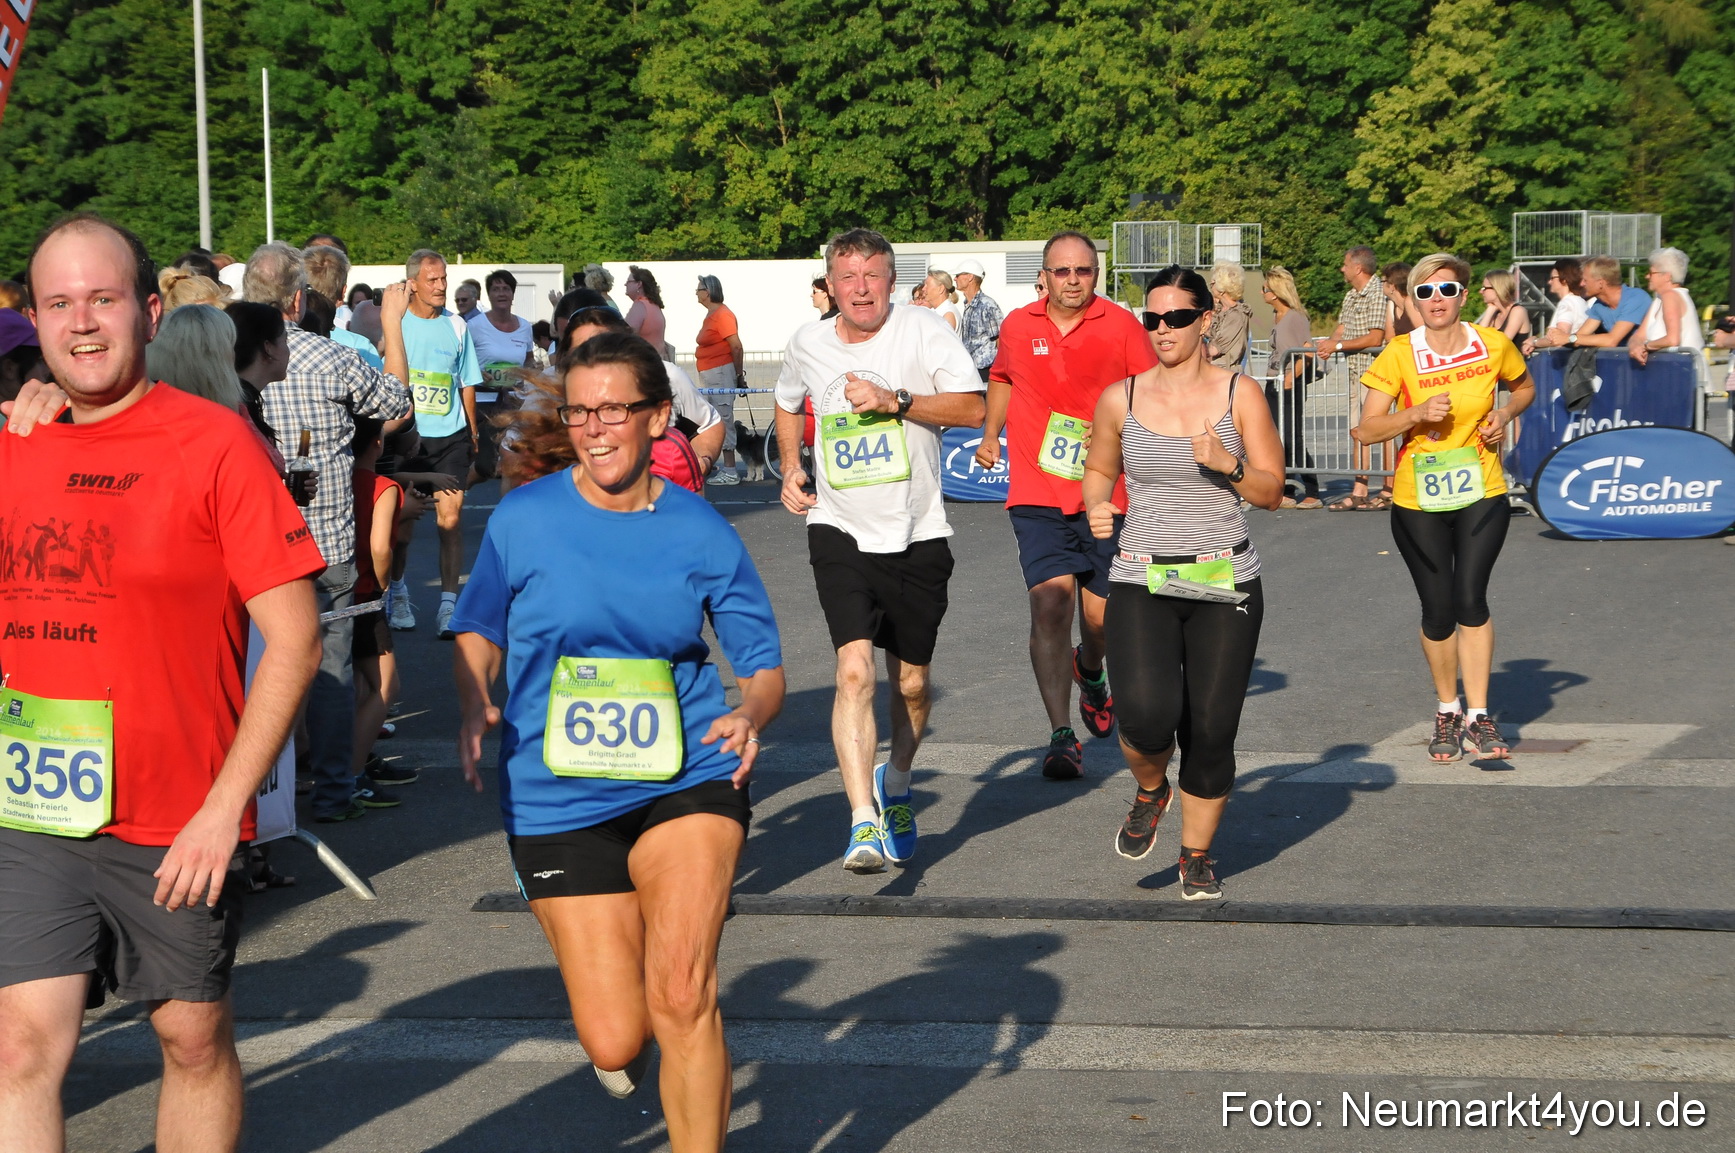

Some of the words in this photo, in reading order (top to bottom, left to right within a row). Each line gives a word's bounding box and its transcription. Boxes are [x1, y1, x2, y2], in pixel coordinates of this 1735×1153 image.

[1418, 375, 1452, 389] MAX
[1456, 364, 1492, 382] BÖGL
[1562, 409, 1655, 443] Fisch
[834, 433, 894, 469] 844
[1050, 436, 1086, 466] 81
[969, 455, 1010, 474] Fs
[1424, 469, 1474, 497] 812
[1589, 475, 1723, 504] Fischer
[1602, 501, 1713, 517] AUTOMOBILE
[285, 526, 308, 544] sw
[1197, 554, 1214, 563] POWER
[1221, 550, 1232, 558] MAN
[43, 620, 98, 643] läuft
[565, 700, 660, 749] 630
[569, 759, 607, 767] Lebenshilfe
[589, 749, 615, 759] Brigitte
[616, 751, 637, 759] Gradl
[6, 742, 103, 803] 356
[3, 807, 35, 820] Stadtwerke
[37, 814, 72, 824] Neumarkt
[6, 796, 39, 809] Sebastian
[40, 802, 69, 812] Feierle
